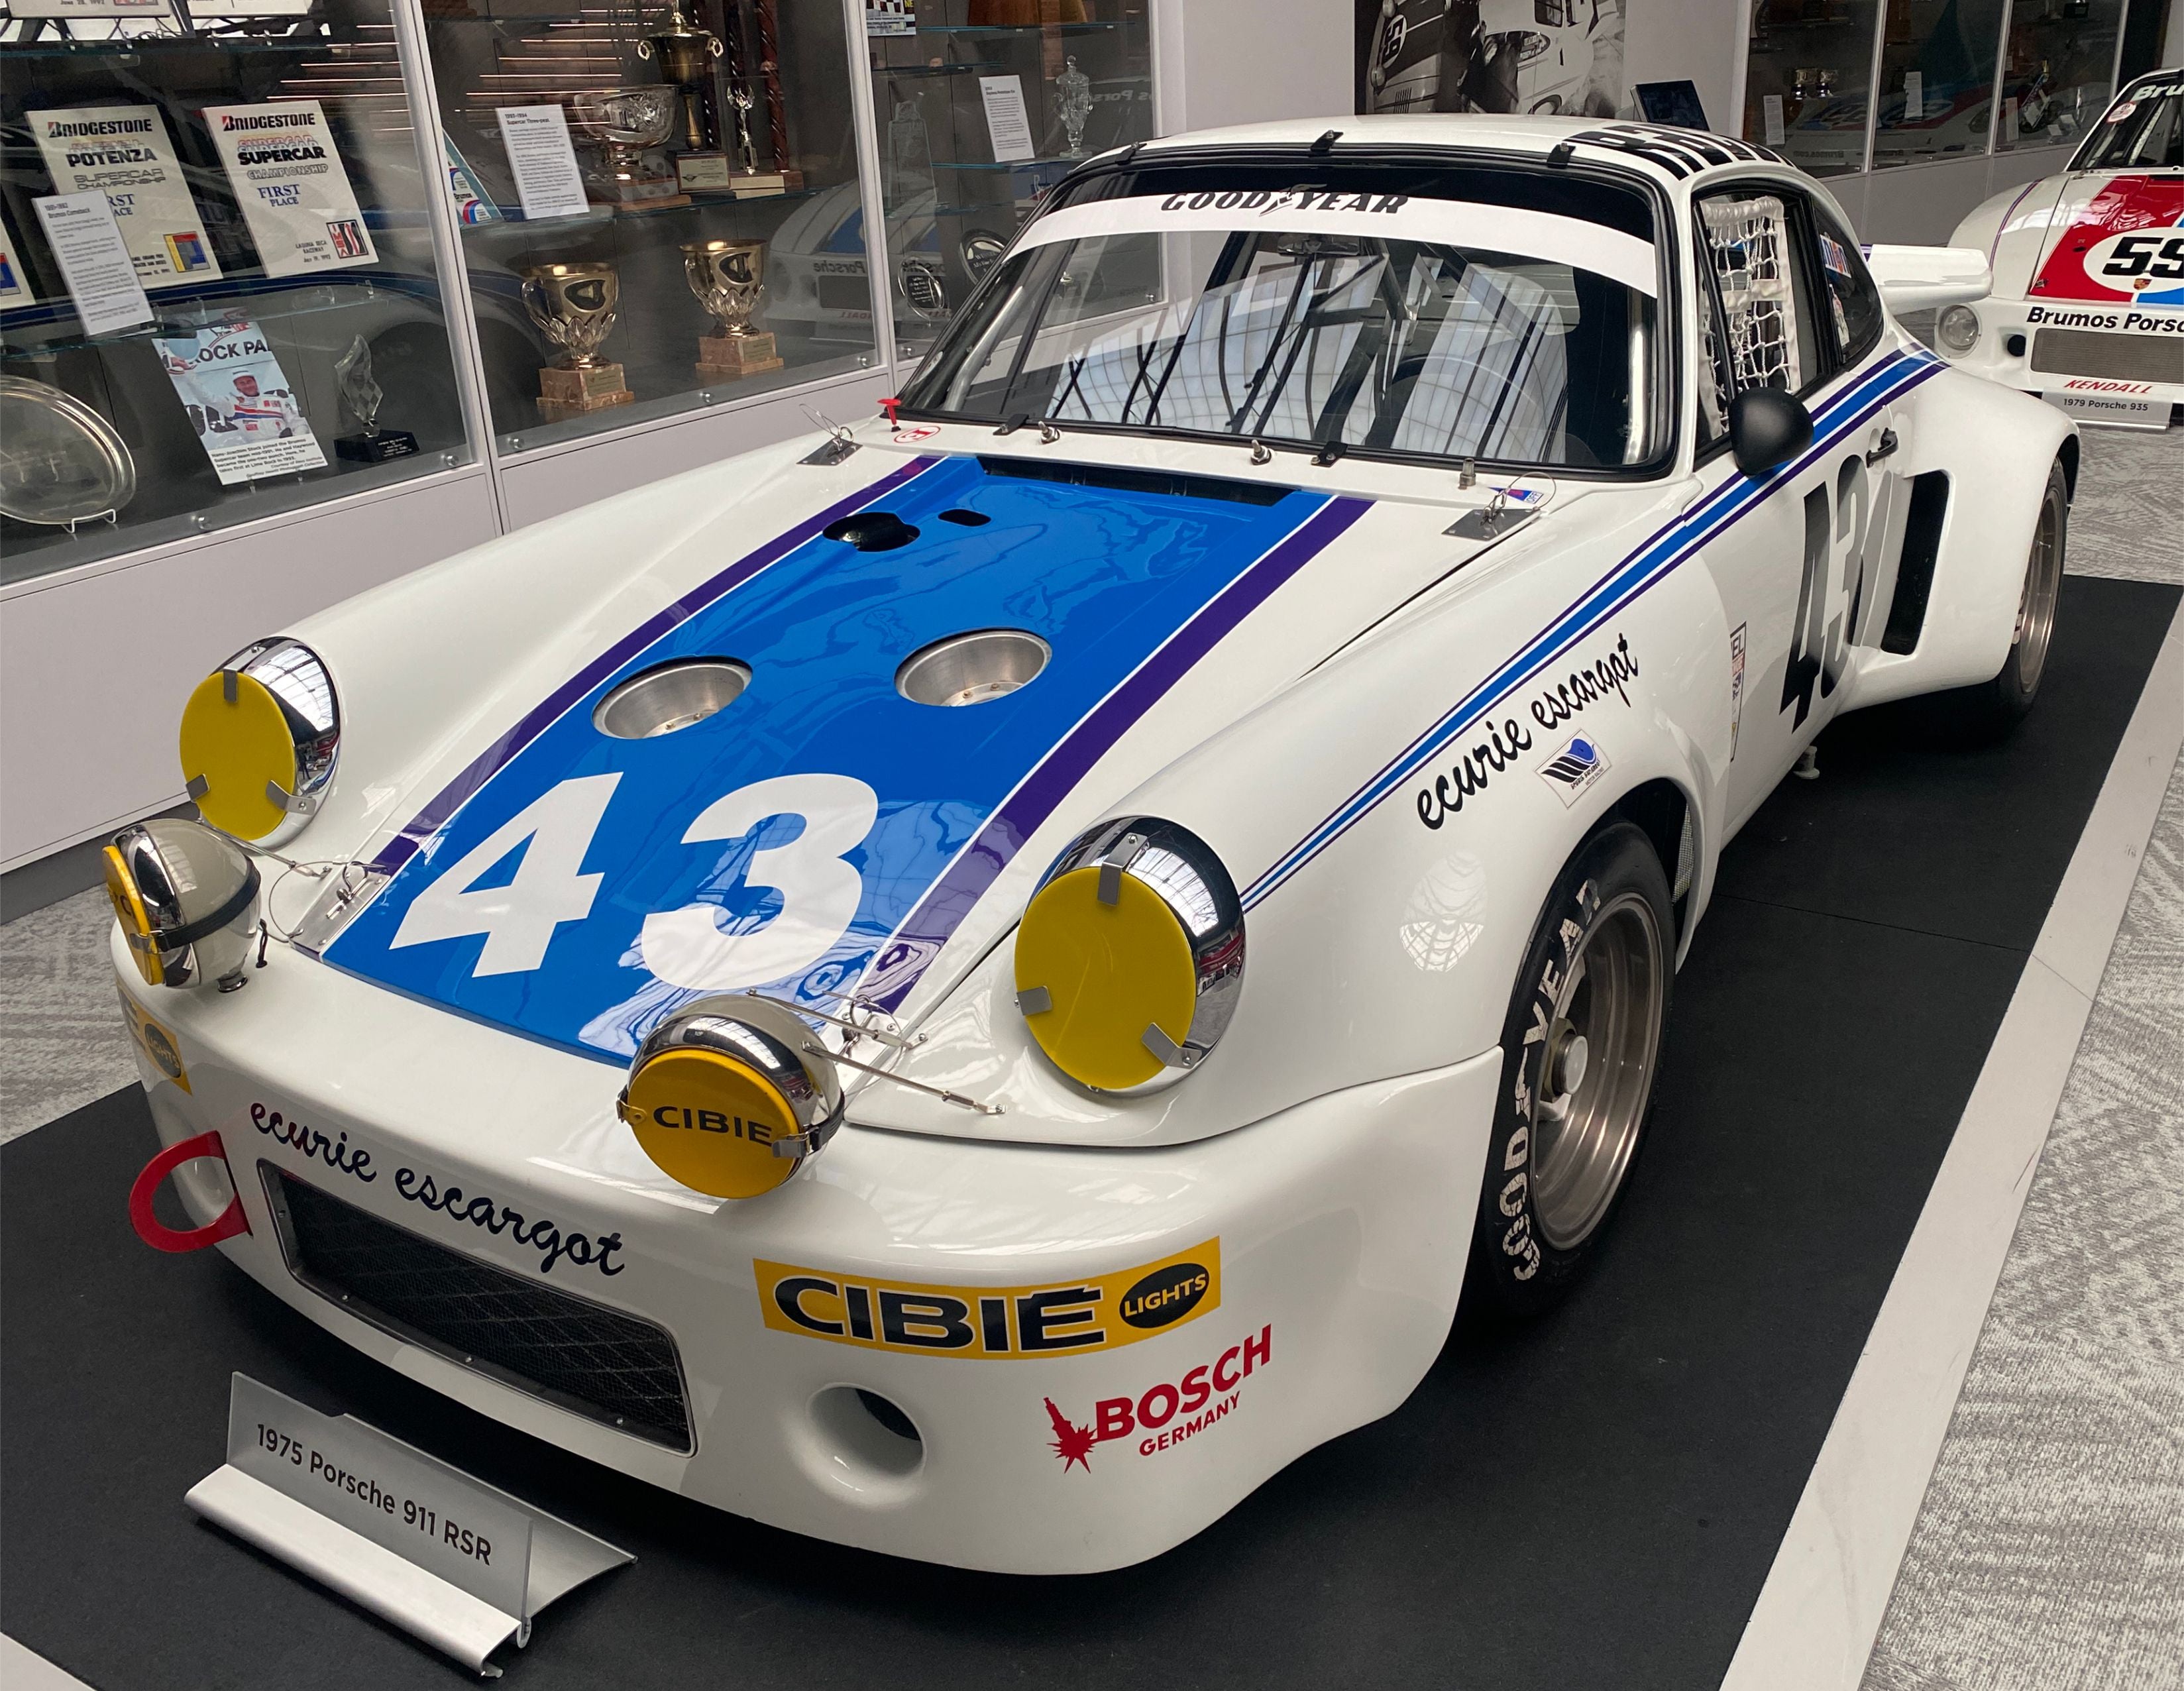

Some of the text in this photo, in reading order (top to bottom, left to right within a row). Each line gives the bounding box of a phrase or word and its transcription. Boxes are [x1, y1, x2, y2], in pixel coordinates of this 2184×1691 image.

[48, 119, 153, 138] BRIDGESTONE
[222, 113, 315, 131] BRIDGESTONE
[66, 148, 158, 167] POTENZA
[238, 146, 327, 166] SUPERCAR
[74, 168, 164, 183] SUPERCAR
[246, 164, 329, 180] CHAMPIONSHIP
[78, 176, 166, 190] CHAMPIONSHIP
[258, 184, 301, 198] FIRST
[107, 194, 135, 207] RST
[270, 197, 300, 207] PLACE
[113, 207, 134, 217] ACE
[2026, 306, 2118, 329] Brumos
[2063, 380, 2154, 394] KENDALL
[2063, 398, 2085, 407] 1979
[2088, 400, 2127, 409] Porsche
[1417, 718, 1532, 830] ecurie
[1531, 633, 1639, 730] escargot
[388, 772, 879, 991] 43
[653, 1105, 773, 1148] CIBIE
[250, 1102, 625, 1276] ecurie escargot
[1124, 1272, 1208, 1319] LIGHTS
[1095, 1323, 1272, 1443] BOSCH
[1139, 1391, 1241, 1457] GERMANY
[257, 1423, 491, 1566] 1975 Porsche 911 RSR
